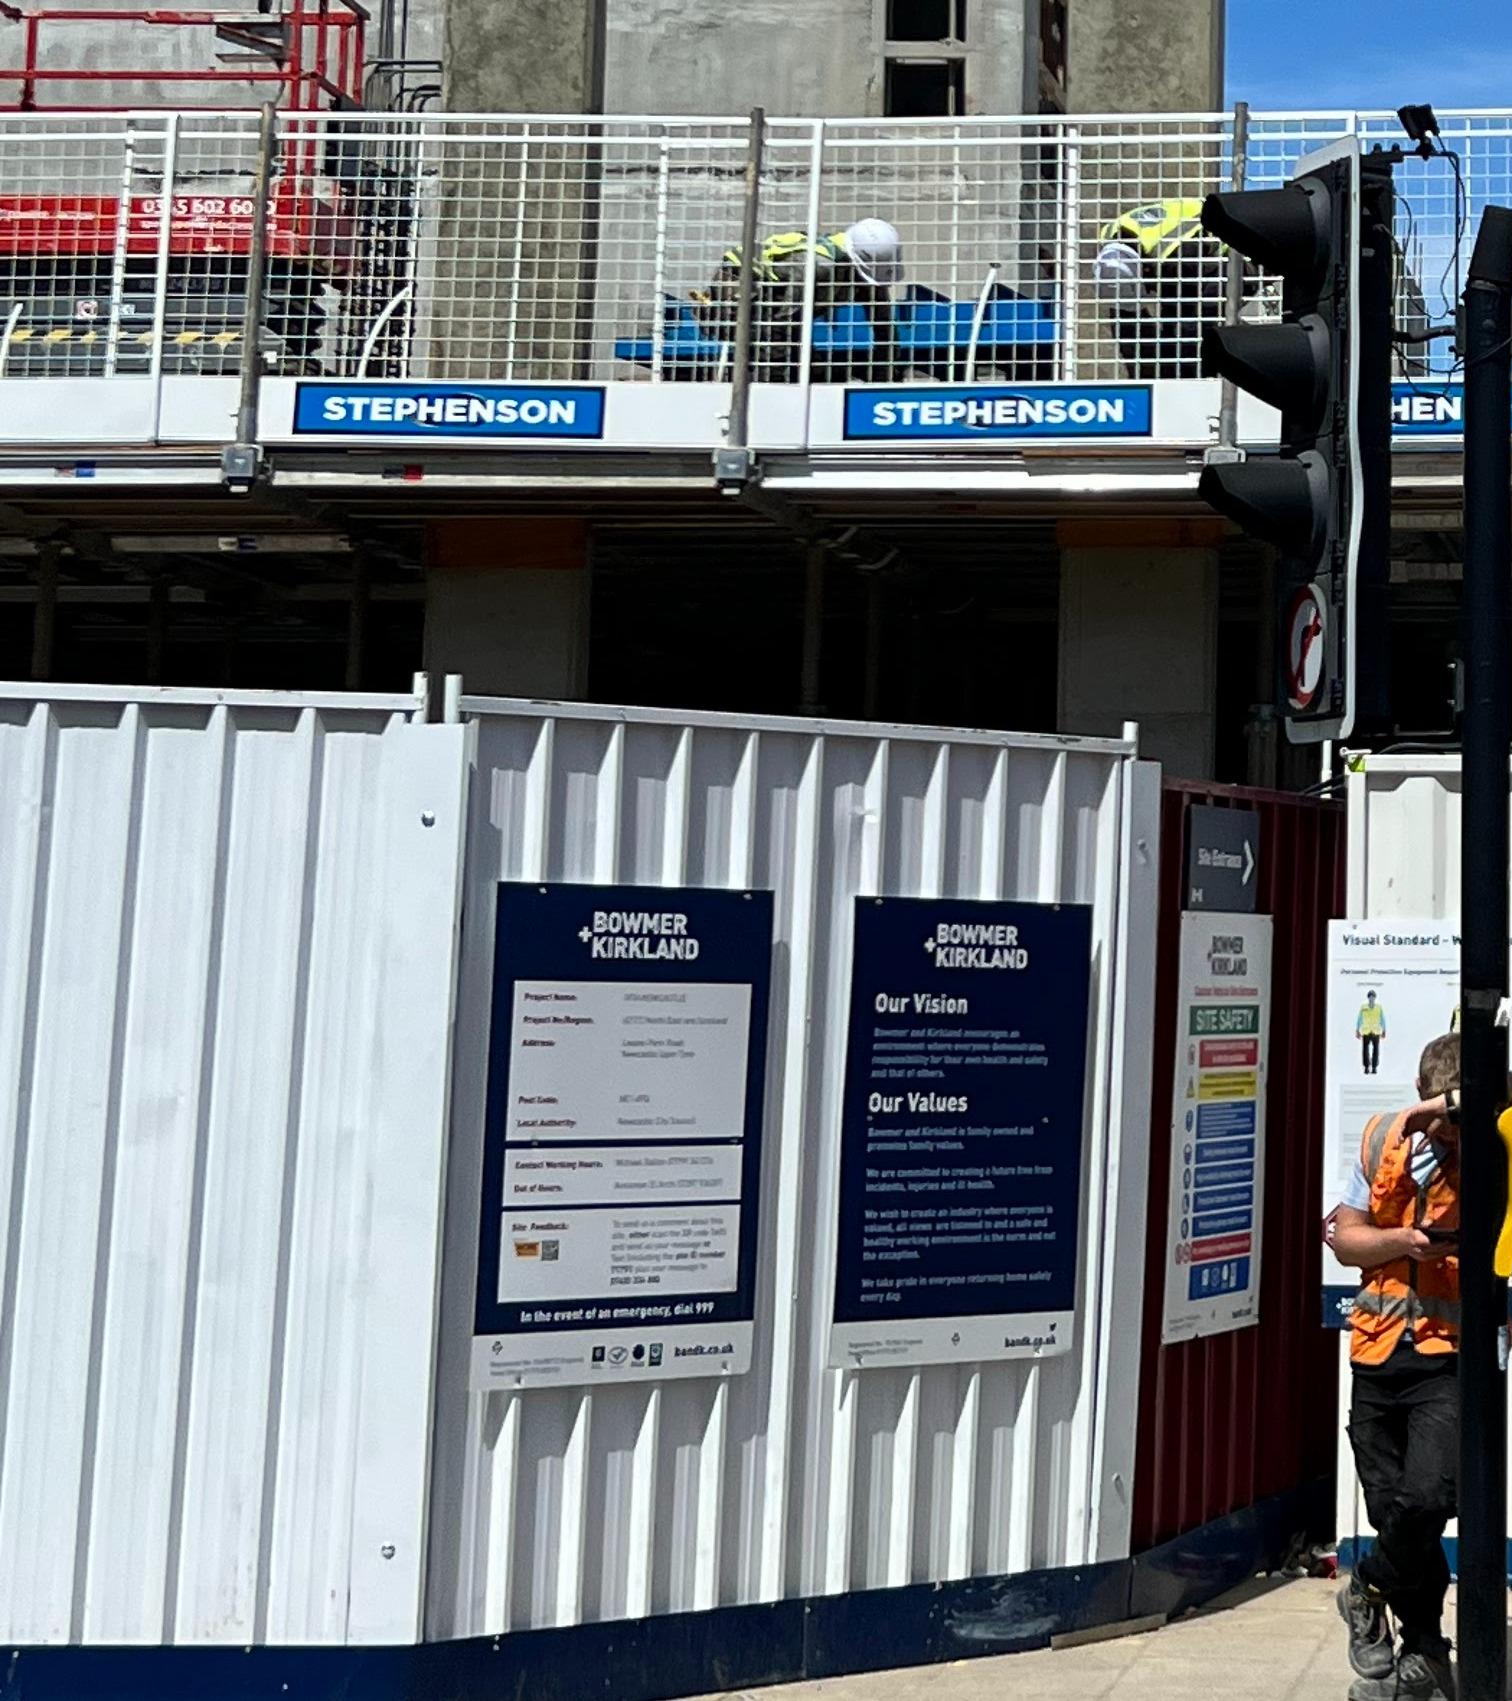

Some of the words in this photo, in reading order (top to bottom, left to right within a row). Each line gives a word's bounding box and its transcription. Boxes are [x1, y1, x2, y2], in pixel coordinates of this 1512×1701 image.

[142, 199, 188, 214] 035
[192, 199, 226, 214] 602
[323, 395, 577, 425] STEPHENSON
[873, 398, 1125, 426] STEPHENSON
[593, 911, 688, 935] BOWMER
[937, 923, 1018, 946] BOWMER
[1342, 934, 1380, 946] Visual
[1383, 934, 1440, 946] Standard
[592, 936, 699, 960] KIRKLAND
[936, 947, 1028, 969] KIRKLAND
[875, 993, 909, 1013] Our
[914, 993, 969, 1014] Vision
[1196, 1008, 1218, 1032] SITE
[1219, 1008, 1254, 1032] SAFETY
[868, 1092, 904, 1113] Our
[907, 1092, 969, 1113] Values
[520, 1310, 533, 1323] In
[534, 1309, 552, 1323] the
[553, 1307, 584, 1321] event
[584, 1306, 597, 1319] of
[597, 1308, 612, 1319] an
[674, 1303, 695, 1316] dial
[695, 1301, 716, 1315] 999
